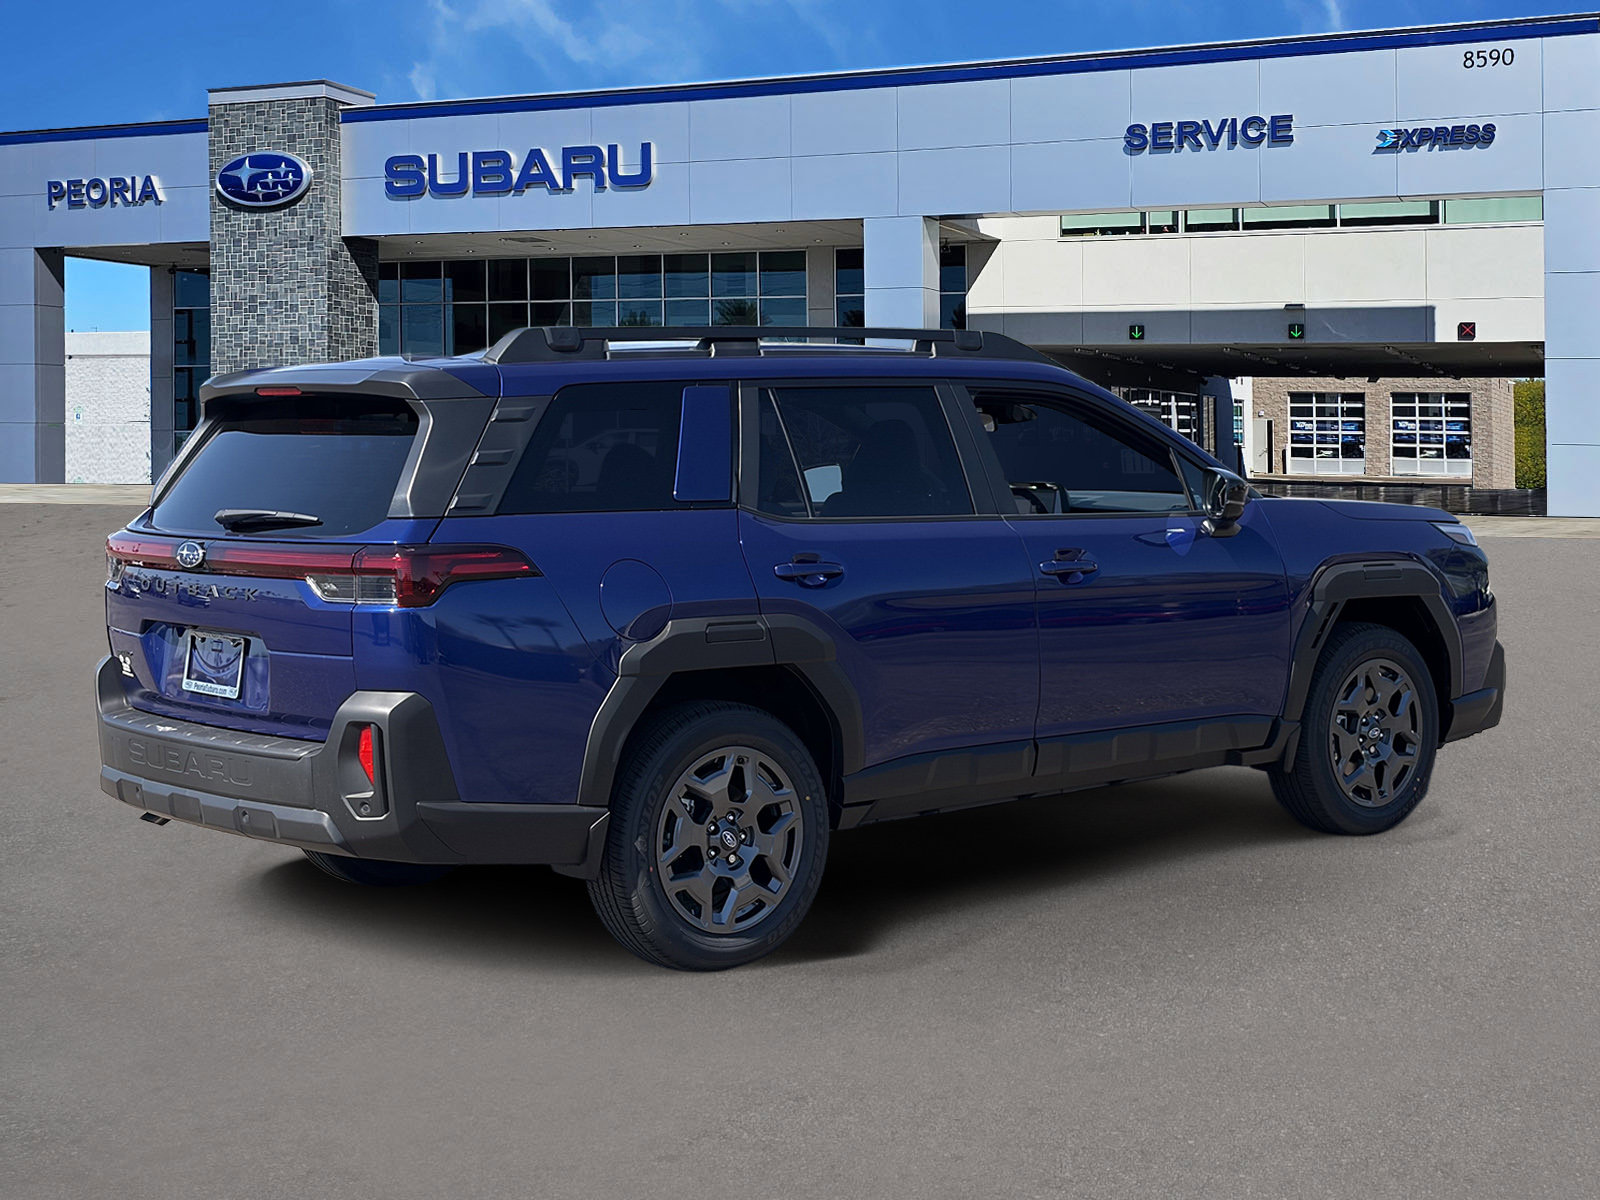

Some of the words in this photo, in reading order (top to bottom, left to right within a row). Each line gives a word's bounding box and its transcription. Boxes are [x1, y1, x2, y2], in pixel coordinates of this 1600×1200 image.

[1463, 48, 1515, 69] 8590
[1125, 114, 1294, 152] SERVICE
[384, 142, 653, 199] SUBARU
[47, 175, 161, 208] PEORIA
[141, 579, 259, 602] OUTBACK
[128, 738, 252, 787] SUBARU
